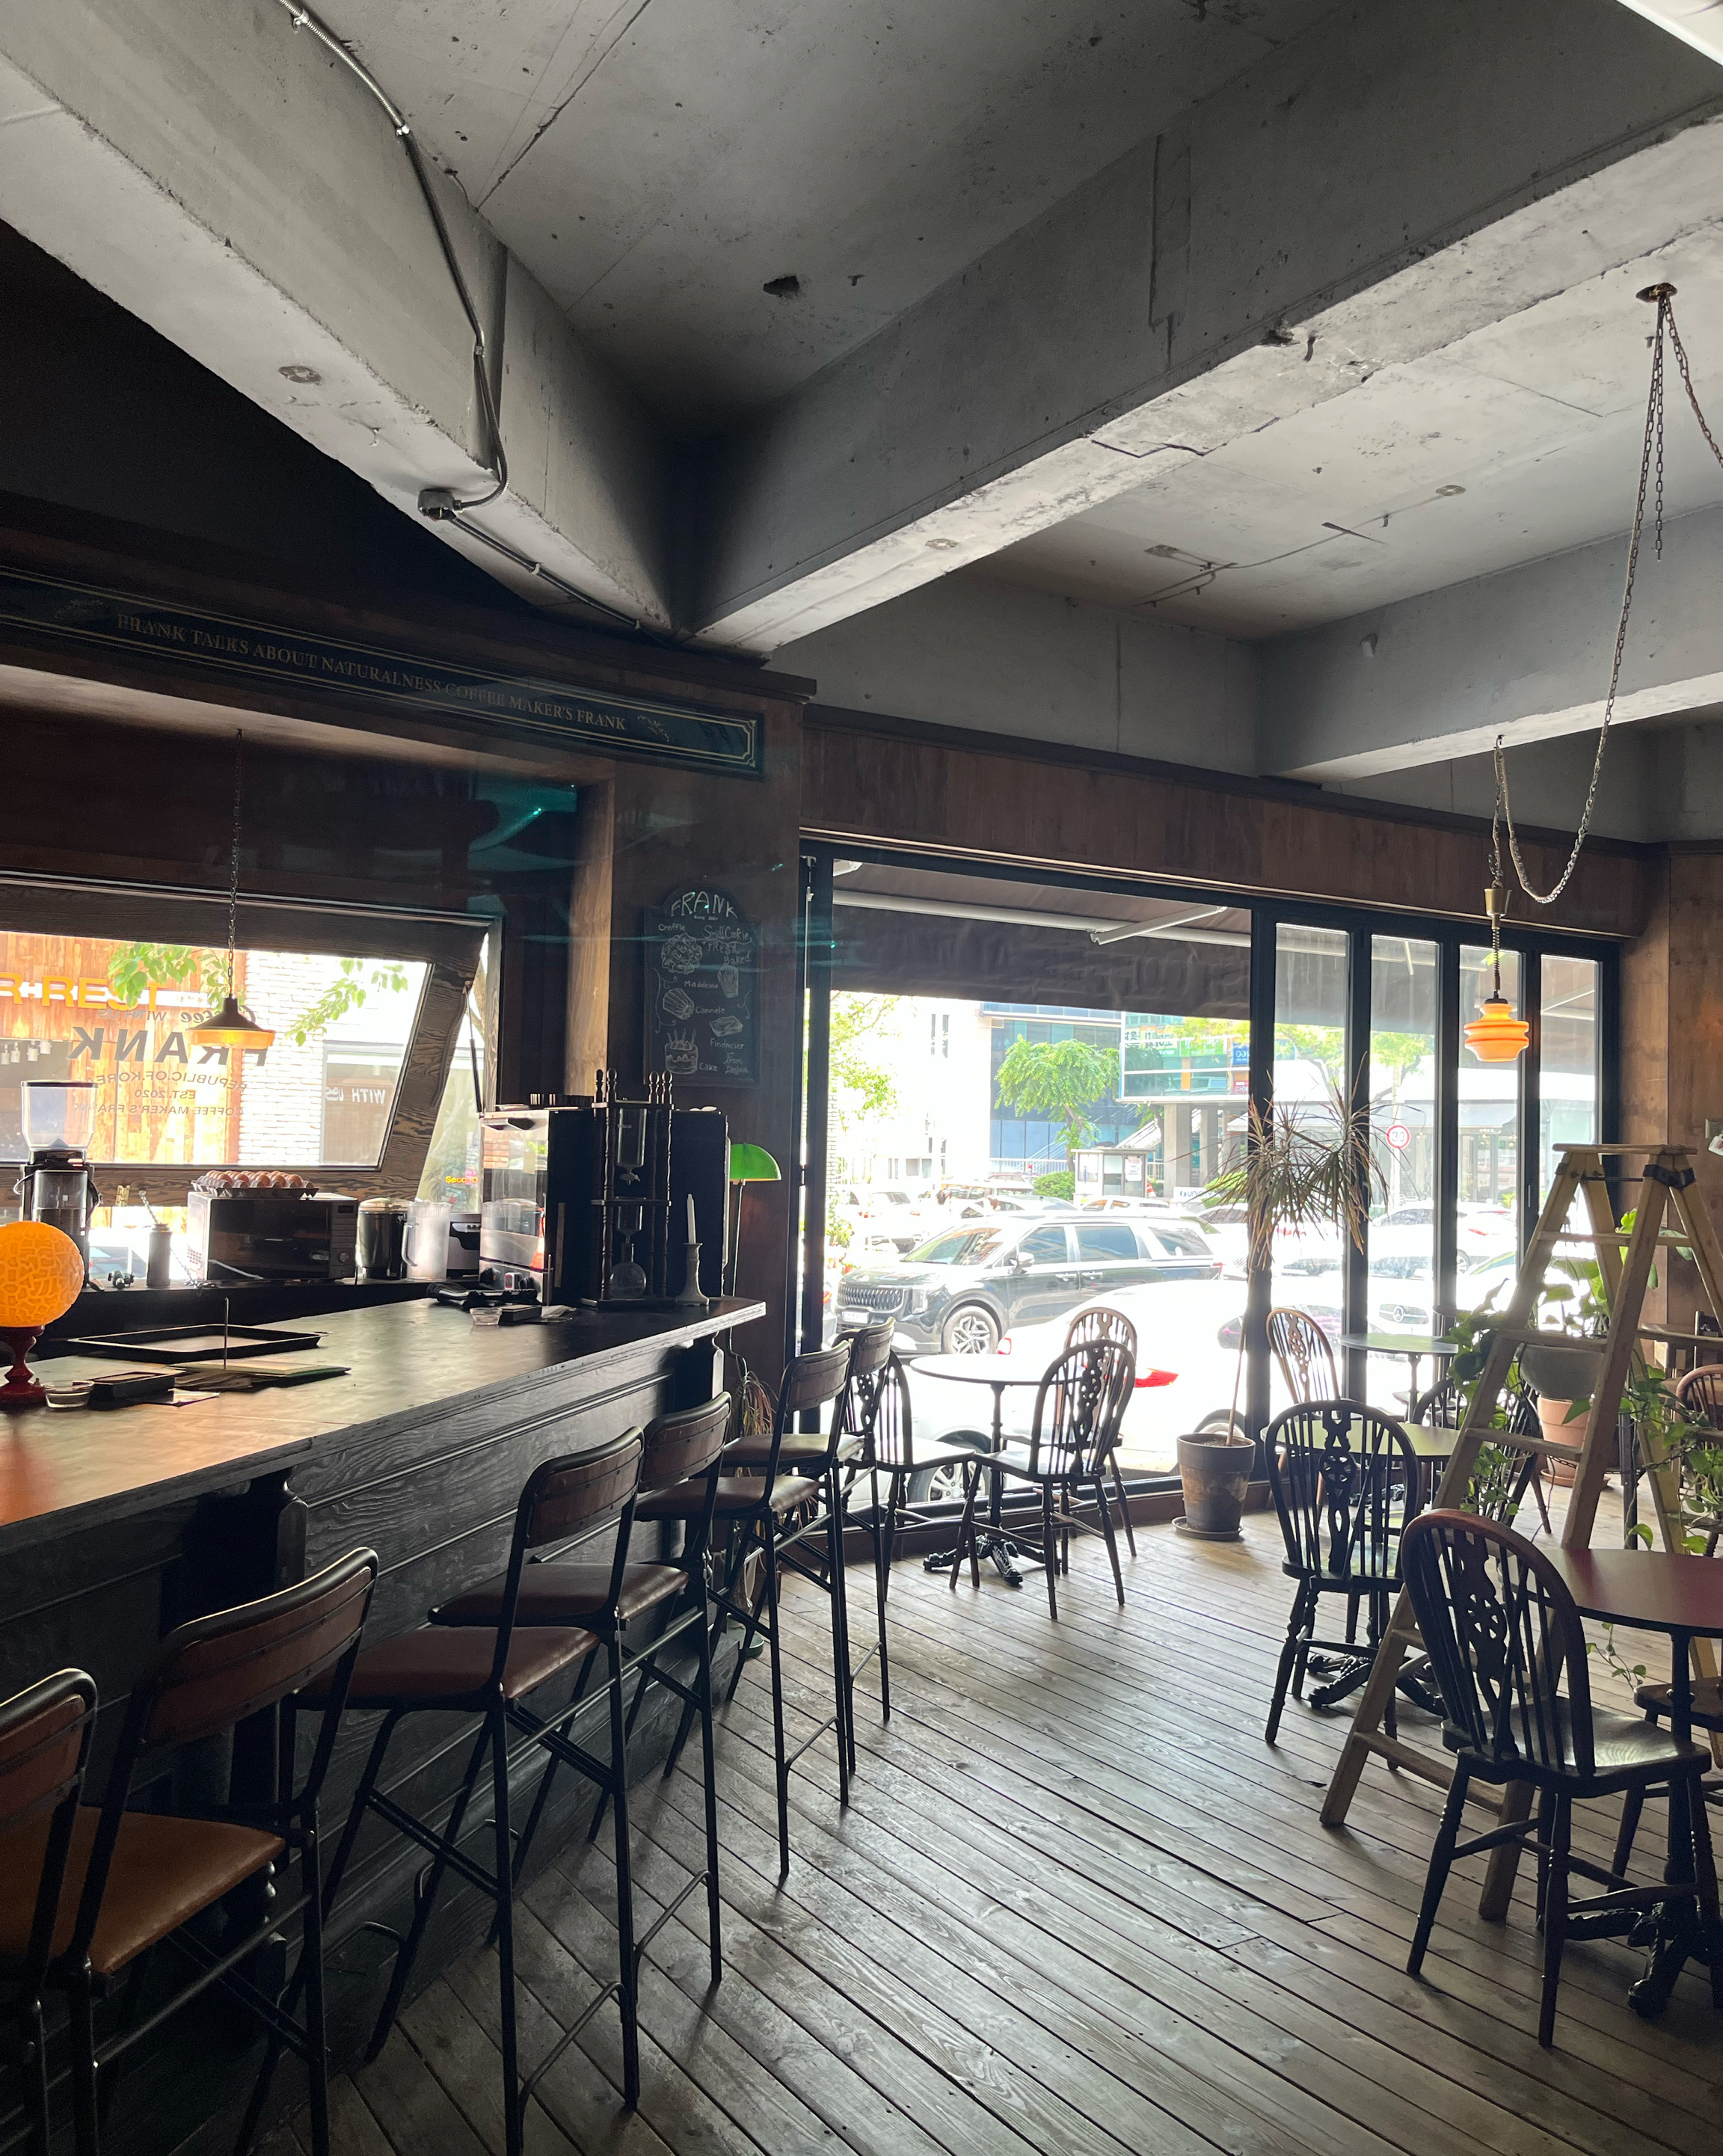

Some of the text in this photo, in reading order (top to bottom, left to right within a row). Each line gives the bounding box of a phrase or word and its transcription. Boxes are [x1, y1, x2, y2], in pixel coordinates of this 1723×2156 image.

[117, 613, 627, 731] FRANK TALKS ABOUT NATURALNESS COFFEE MAKER'S FRANK
[698, 1062, 718, 1072] Cake
[1392, 1131, 1404, 1142] 30
